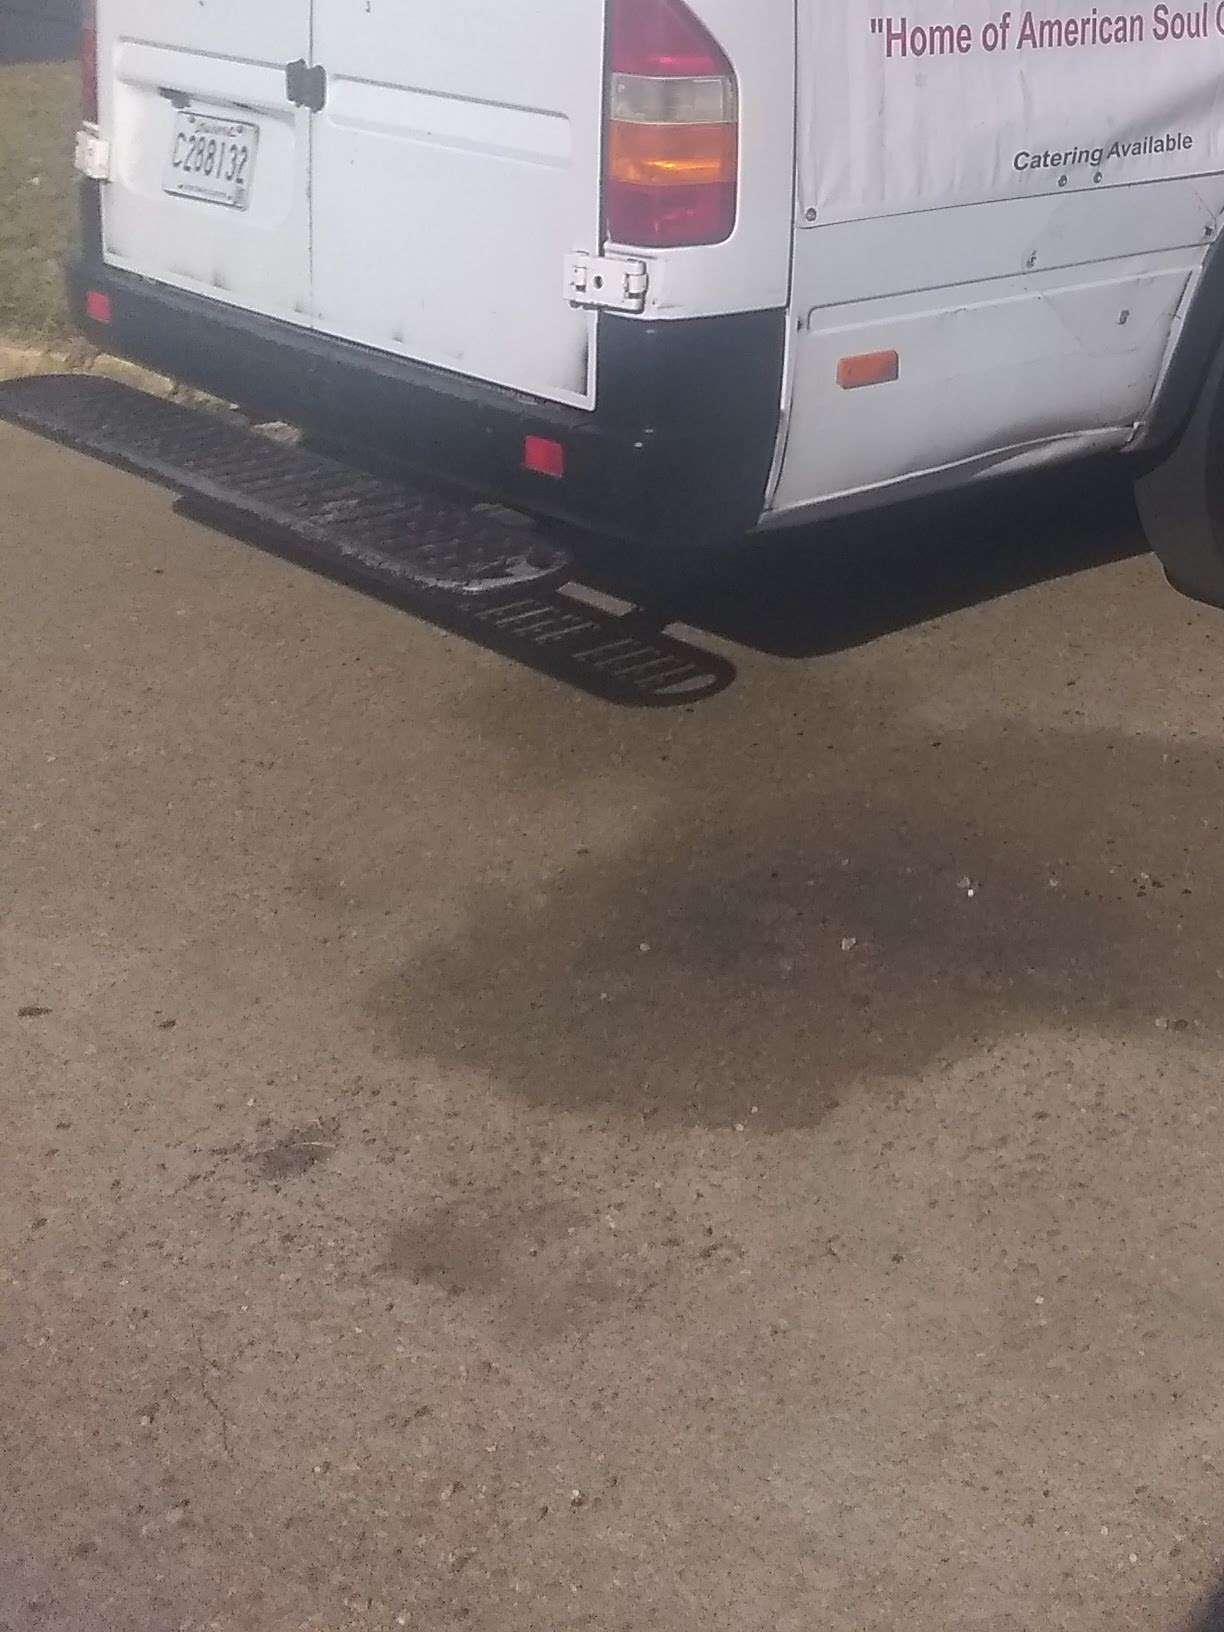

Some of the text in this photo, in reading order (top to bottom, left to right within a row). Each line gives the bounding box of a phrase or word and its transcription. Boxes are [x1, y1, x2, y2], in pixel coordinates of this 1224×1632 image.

[870, 17, 972, 58] "Home
[981, 11, 1012, 52] of
[1015, 8, 1144, 50] American
[1152, 0, 1209, 42] Soul
[1013, 132, 1193, 171] Catering Available
